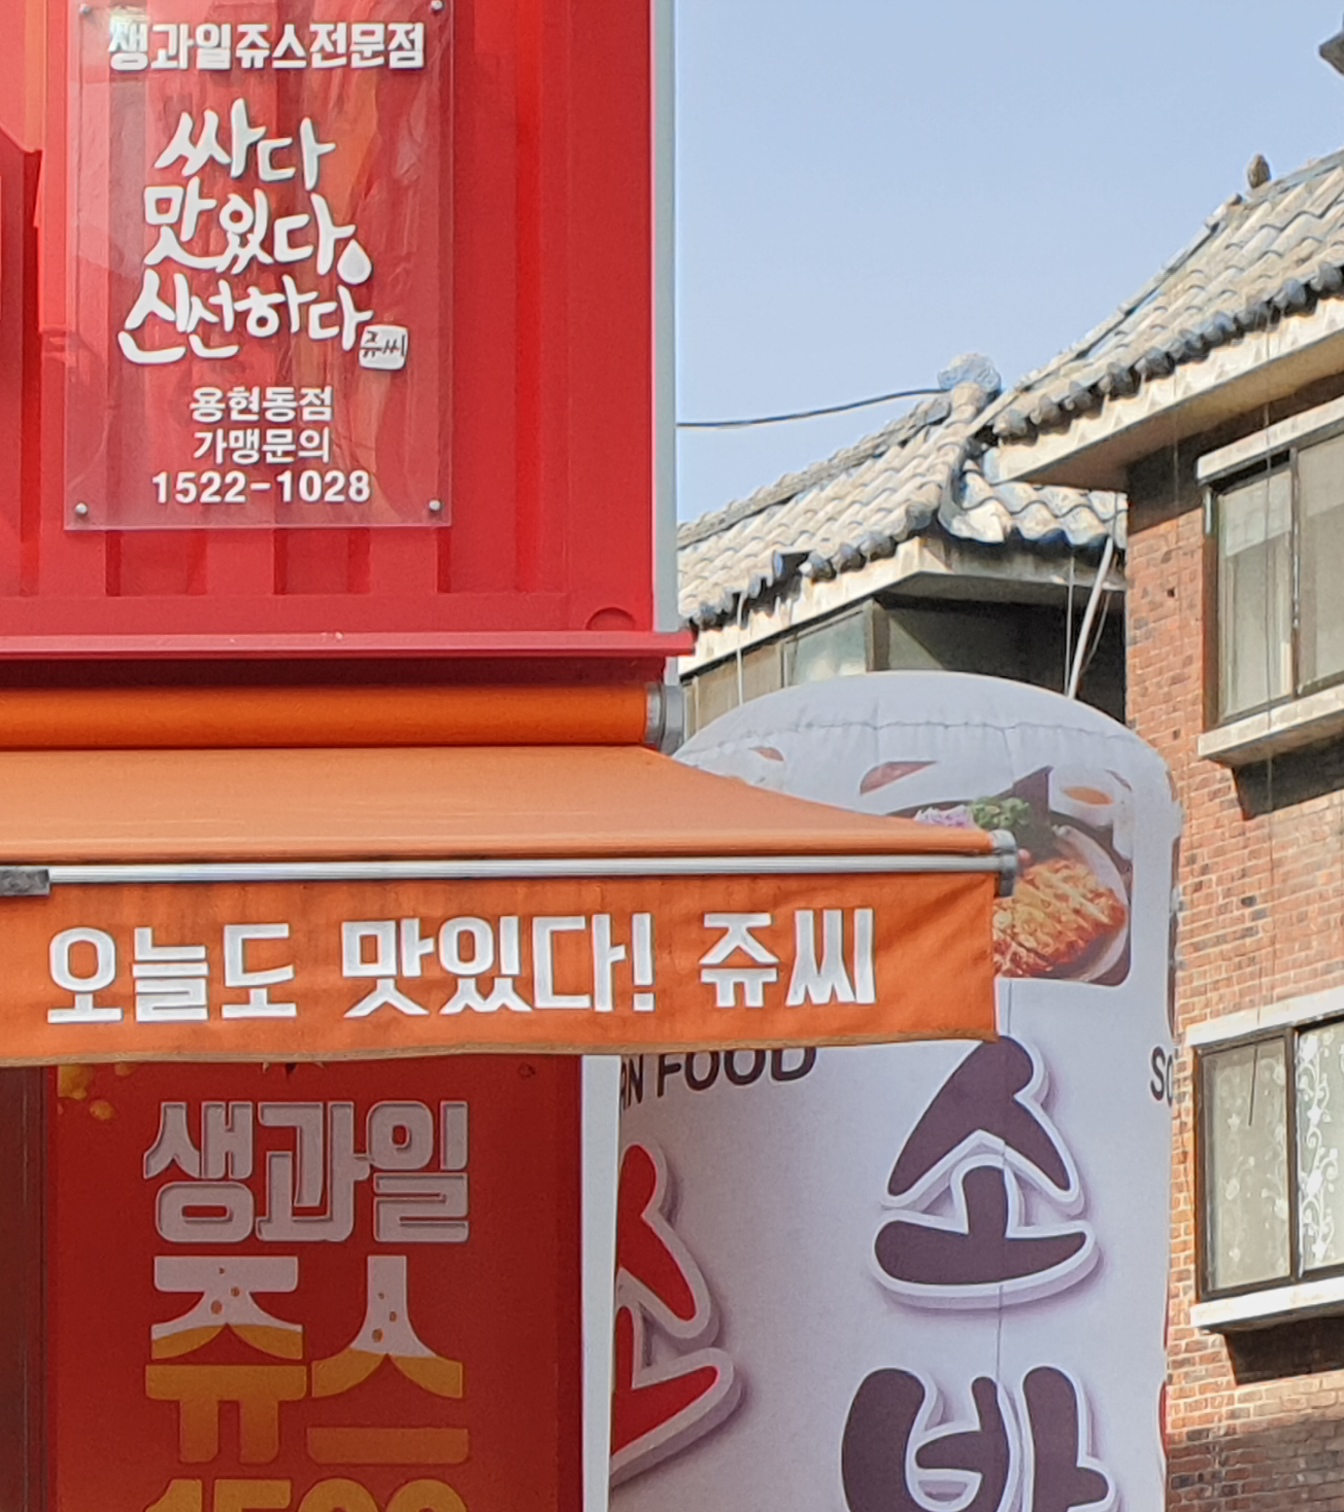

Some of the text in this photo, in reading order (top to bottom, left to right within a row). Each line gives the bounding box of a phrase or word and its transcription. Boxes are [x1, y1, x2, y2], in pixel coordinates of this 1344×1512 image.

[108, 22, 425, 70] 생과일쥬스전문점
[154, 98, 336, 191] 싸다
[143, 177, 357, 276] 맛있다
[117, 268, 374, 364] 신선하다
[189, 385, 334, 424] 용현동점
[193, 426, 331, 465] 가맹문의
[151, 469, 372, 504] 1522-1028
[45, 907, 876, 1023] 오늘도 맛있다! 쥬씨
[657, 1047, 817, 1098] FOOD
[142, 1100, 471, 1244] 생과일
[144, 1255, 470, 1465] 쥬스
